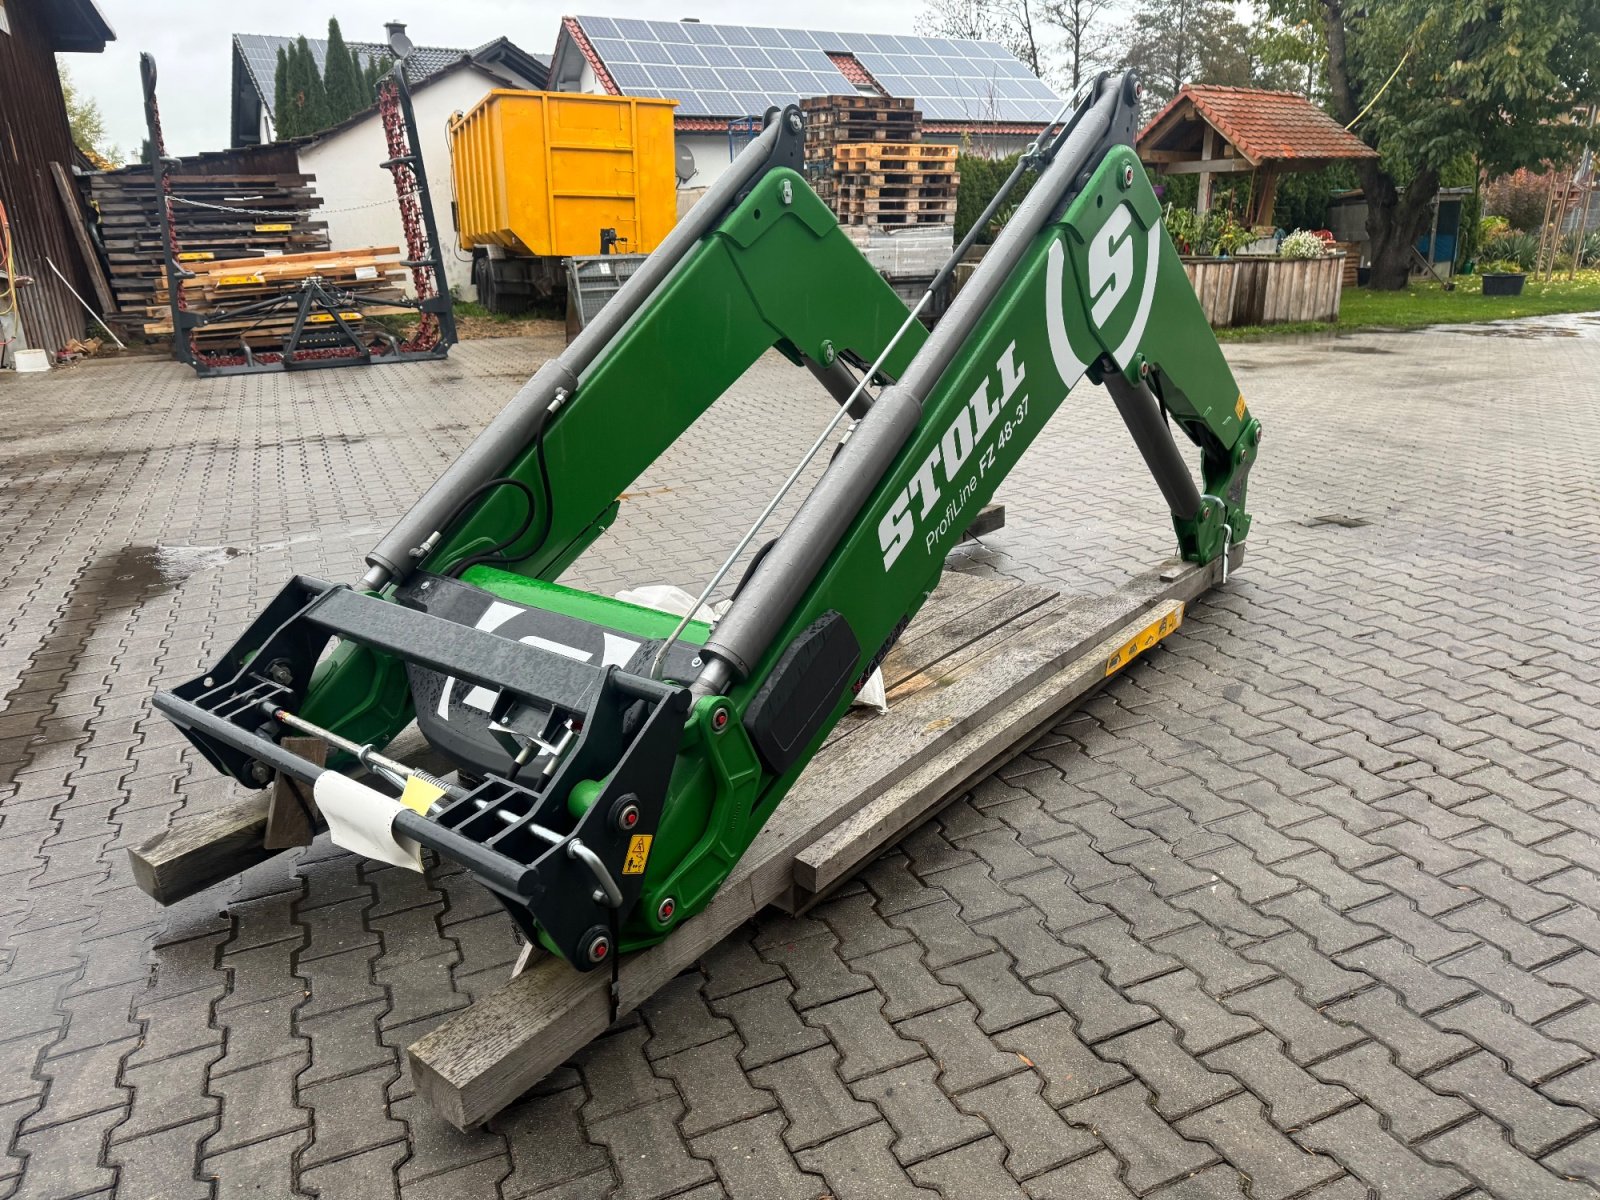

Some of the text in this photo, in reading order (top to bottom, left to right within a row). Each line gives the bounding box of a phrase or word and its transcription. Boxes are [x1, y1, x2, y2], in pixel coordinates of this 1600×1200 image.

[1089, 203, 1134, 330] S
[878, 339, 1026, 572] STOLL
[926, 395, 1029, 554] ProfiLine FZ 48-37
